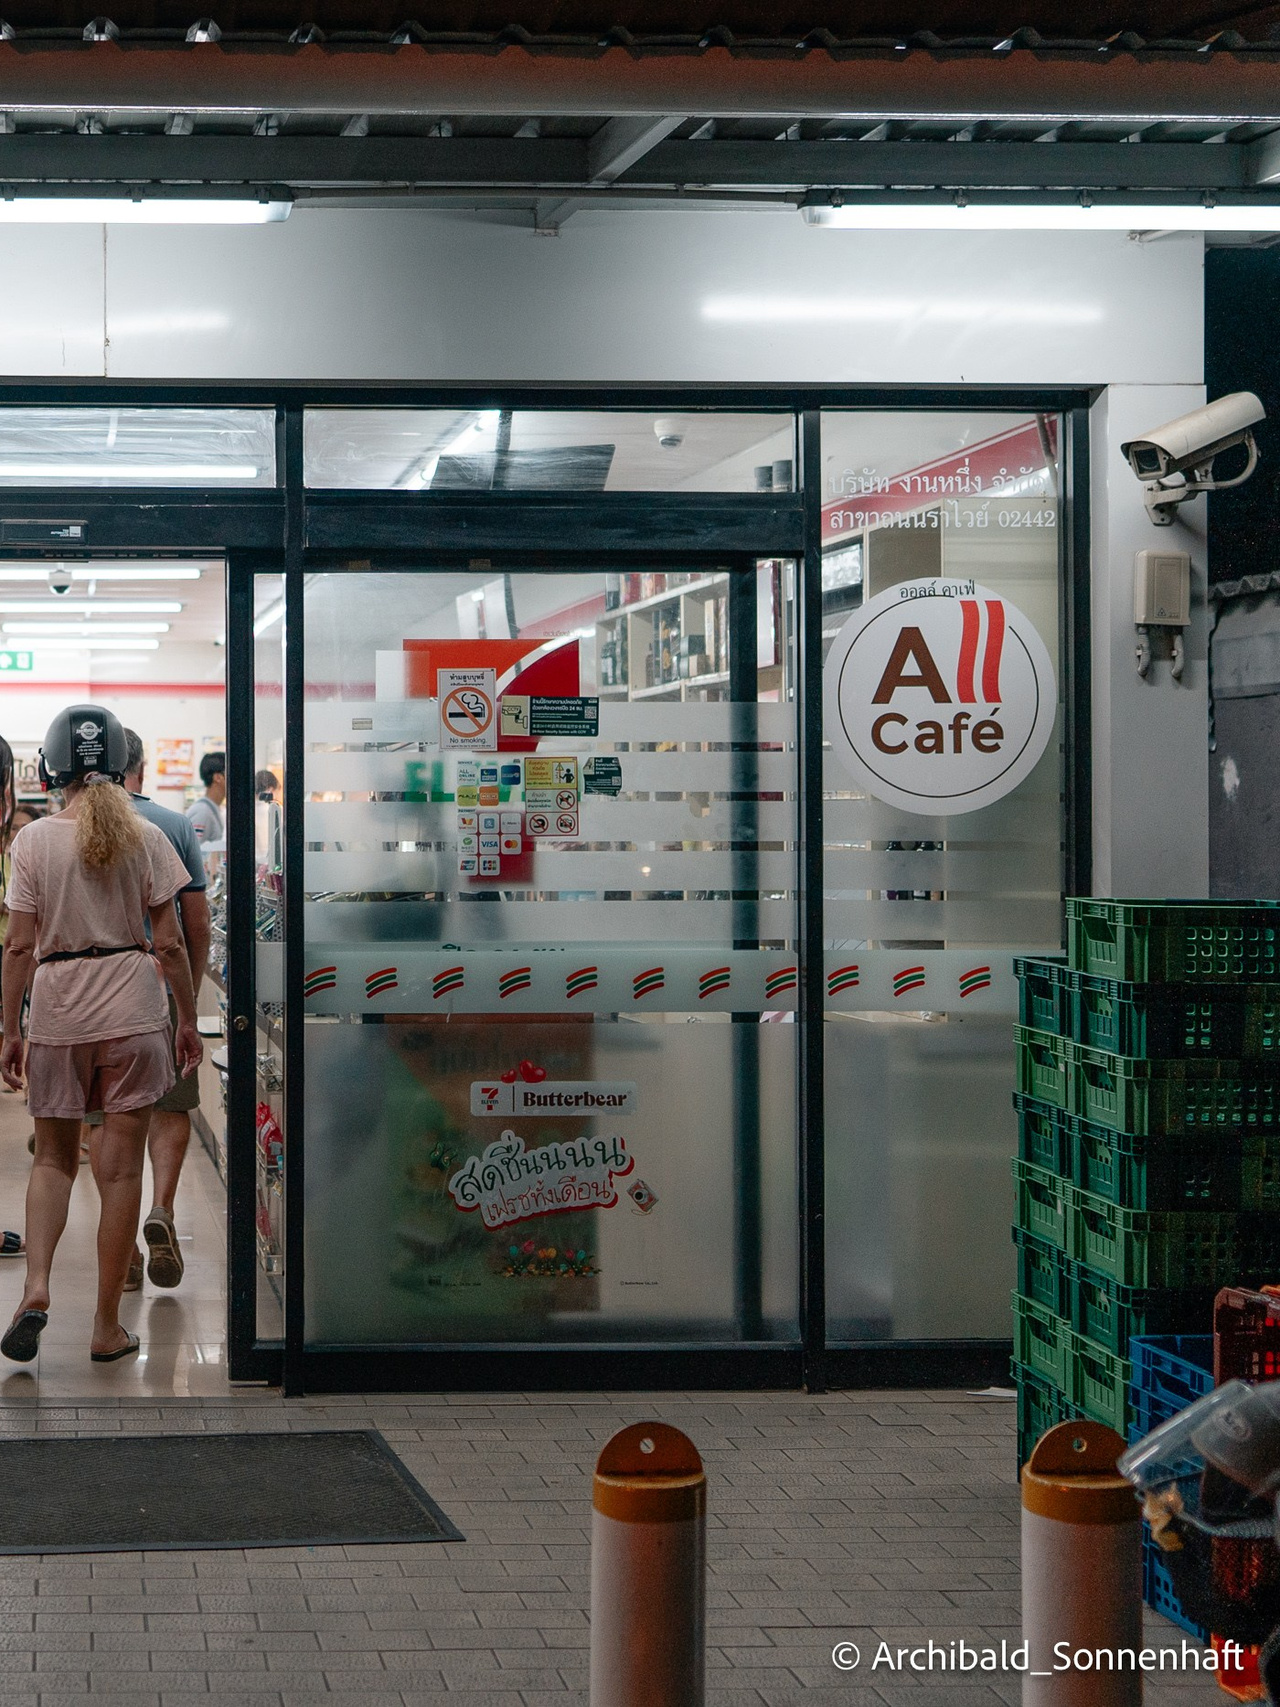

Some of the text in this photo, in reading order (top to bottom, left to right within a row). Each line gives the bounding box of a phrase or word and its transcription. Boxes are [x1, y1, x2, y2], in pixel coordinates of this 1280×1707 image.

[829, 467, 890, 495] บริษัท
[900, 458, 982, 494] งานหนึ่ง
[830, 499, 1057, 529] สาขาถนนราไวย์ 02442
[900, 578, 976, 598] ออลล์ คาเฟ่
[871, 600, 1005, 704] All
[871, 707, 1005, 755] Café
[523, 1091, 628, 1107] Butterbear
[455, 1135, 626, 1202] สดชื่นนนน
[488, 1175, 611, 1222] เฟรชทั้งเดือน
